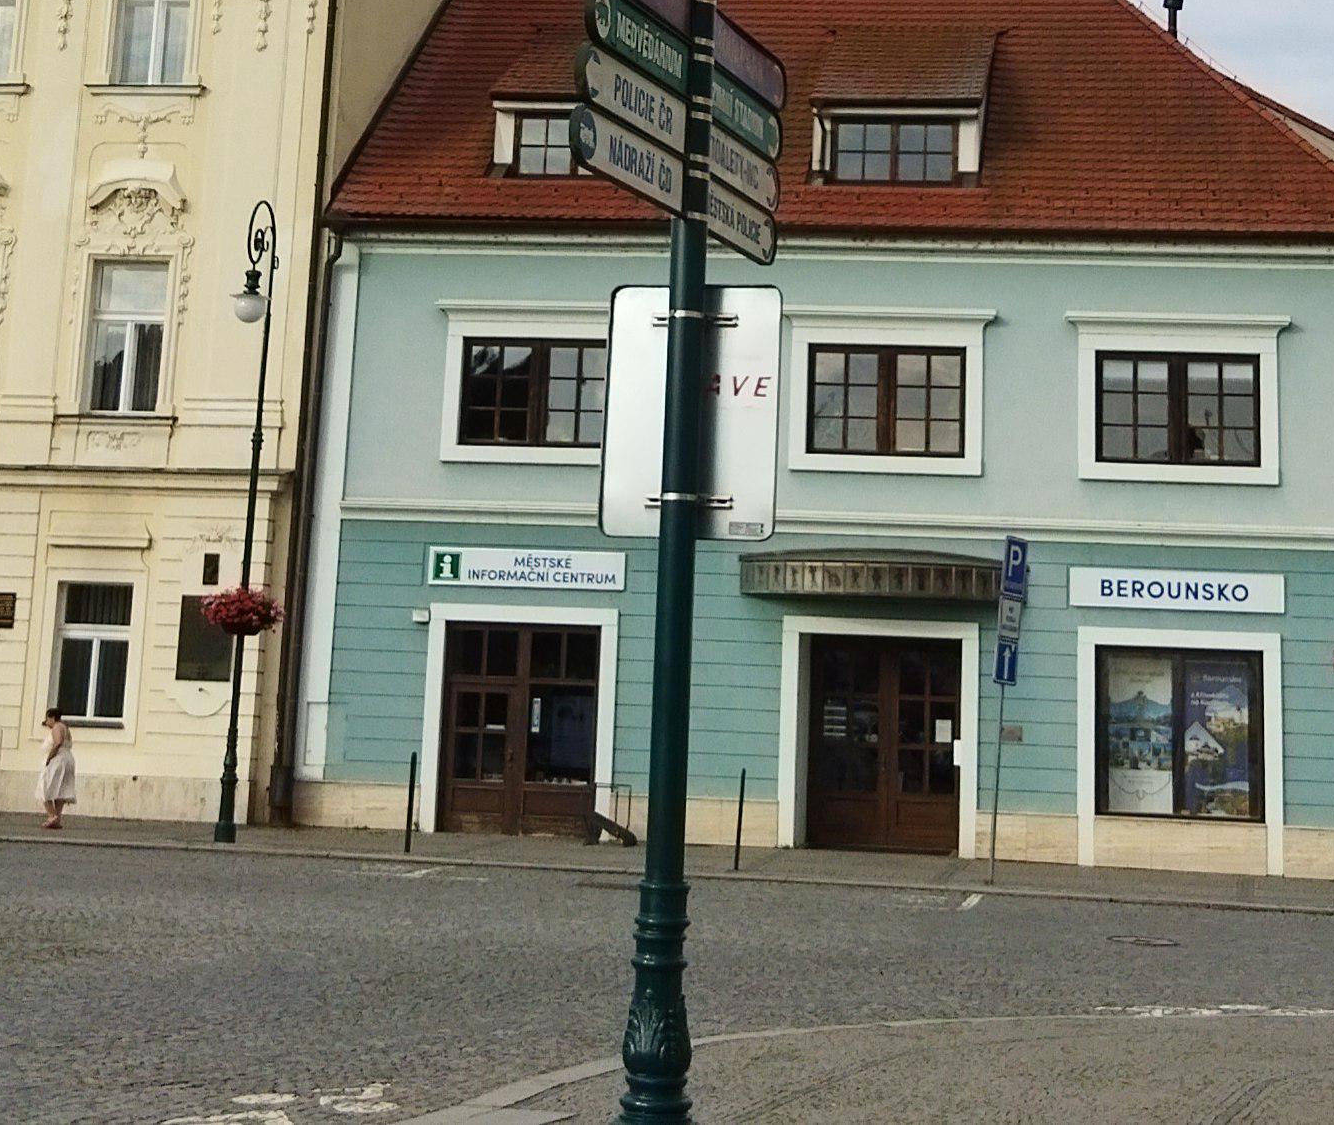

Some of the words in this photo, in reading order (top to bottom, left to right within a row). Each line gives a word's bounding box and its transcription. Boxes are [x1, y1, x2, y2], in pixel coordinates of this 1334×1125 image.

[616, 10, 682, 79] MEDVĚDÁRIUM
[614, 74, 655, 125] POLICIE
[659, 97, 673, 135] ČR
[609, 133, 655, 185] NÁDRAŽÍ
[658, 157, 673, 194] ČD
[710, 189, 735, 230] ĚSTSKÁ
[468, 567, 549, 583] INFORMAČNÍ
[553, 571, 617, 585] CENTRUM
[513, 553, 573, 569] MĚSTSKÉ
[1008, 544, 1023, 577] P
[1099, 578, 1250, 602] BEROUNSKO
